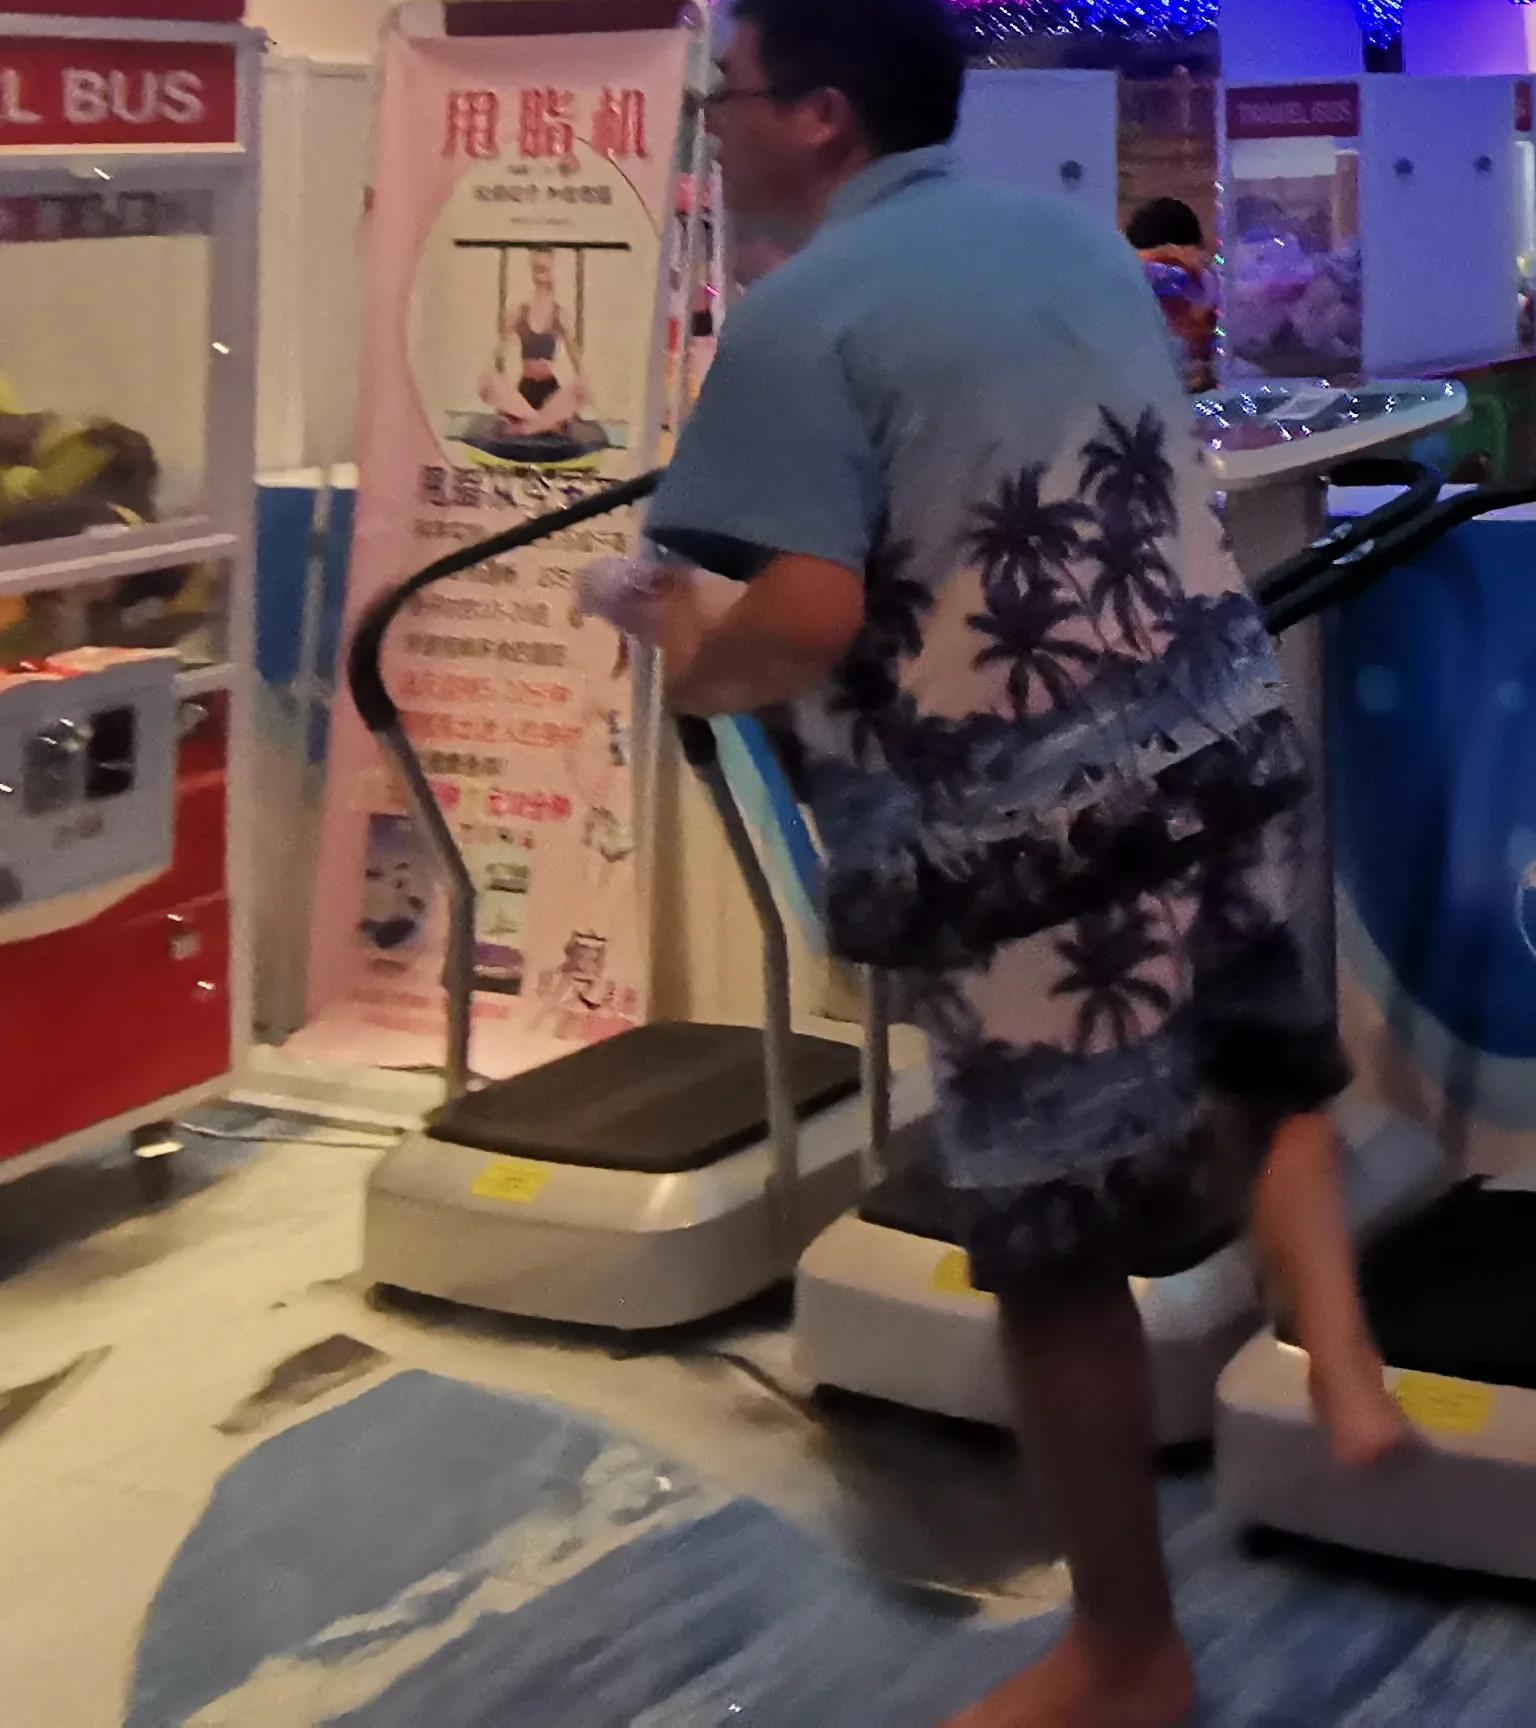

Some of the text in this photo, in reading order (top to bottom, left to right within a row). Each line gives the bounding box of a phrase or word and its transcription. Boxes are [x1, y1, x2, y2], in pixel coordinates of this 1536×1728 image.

[61, 66, 205, 125] BUS
[441, 85, 648, 159] 甩脂机
